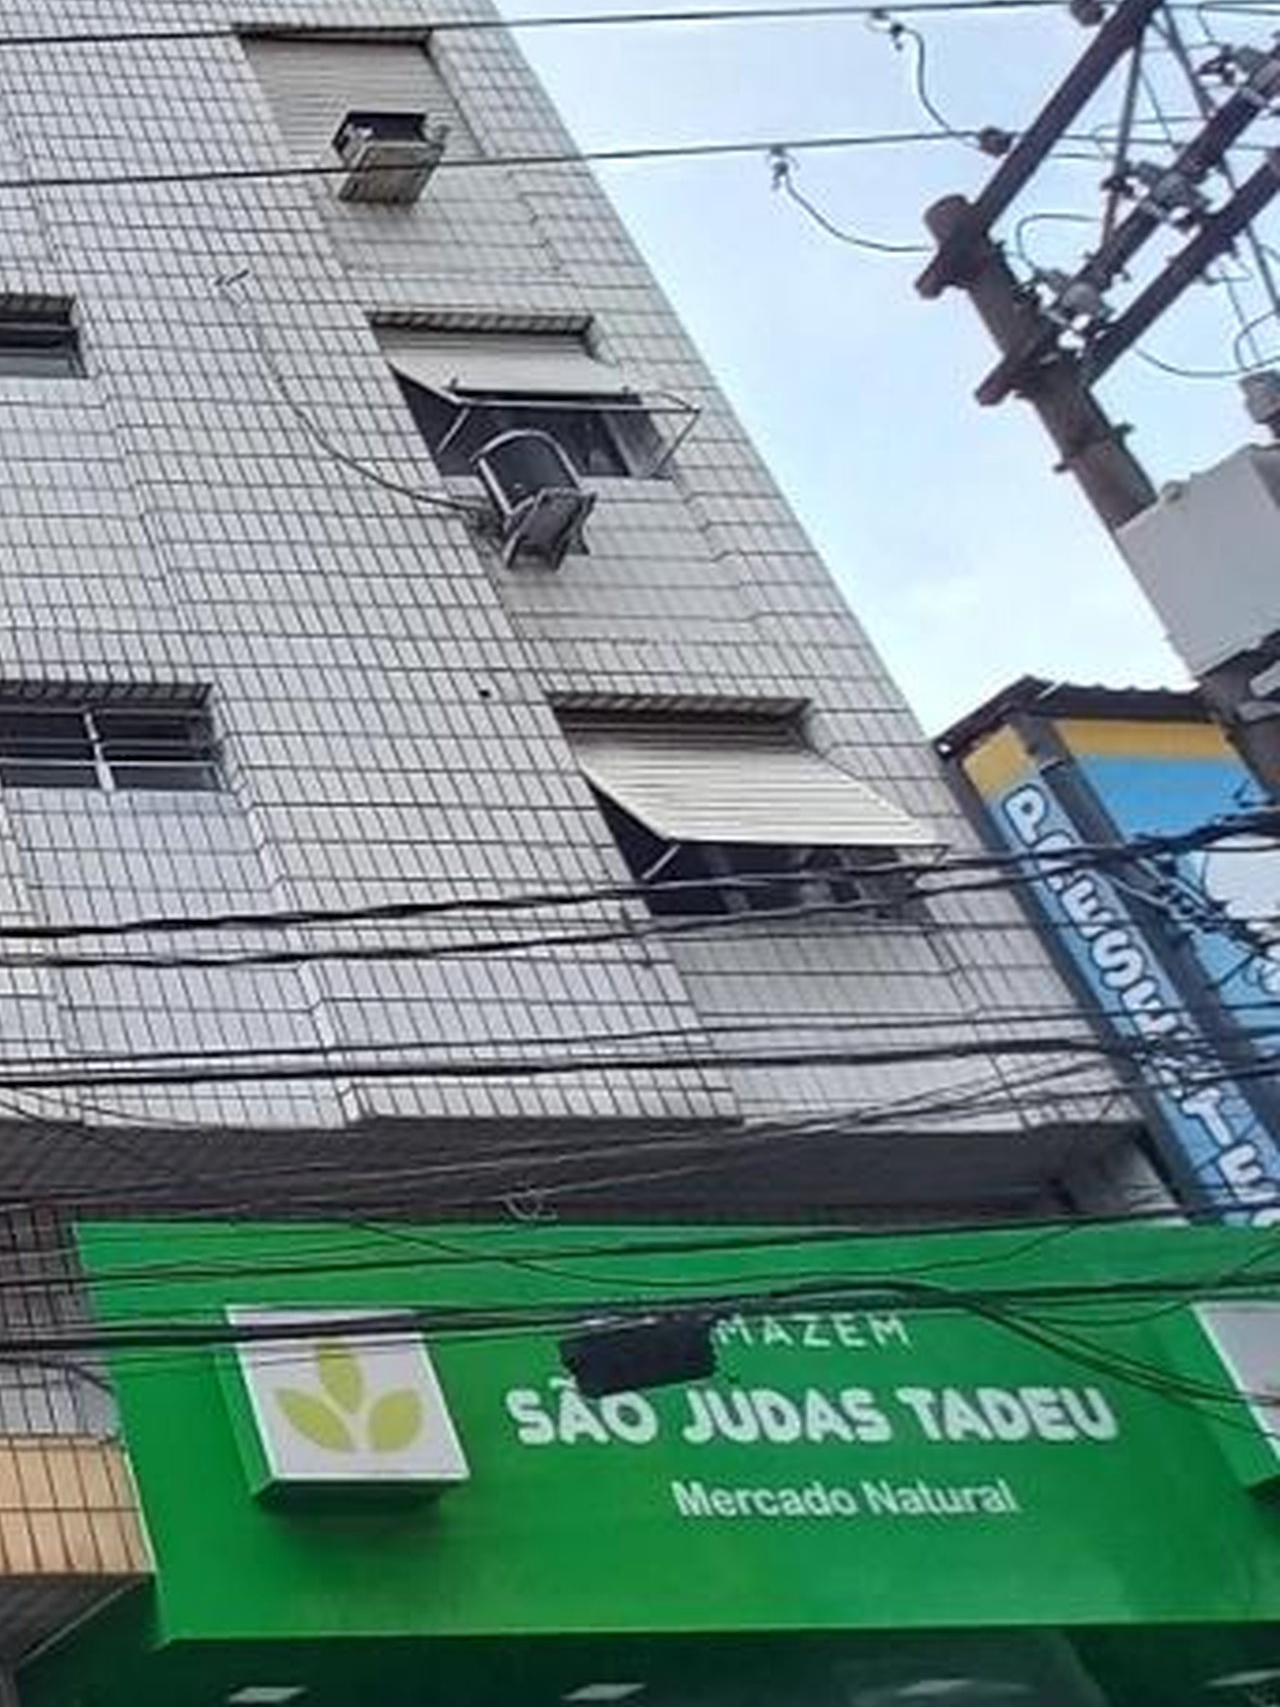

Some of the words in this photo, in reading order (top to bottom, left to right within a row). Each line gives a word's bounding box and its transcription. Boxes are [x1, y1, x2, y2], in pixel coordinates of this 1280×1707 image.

[504, 1376, 659, 1445] SÃO
[682, 1386, 893, 1445] JUDAS
[896, 1386, 1121, 1443] TADEU
[671, 1479, 861, 1520] Mercado
[862, 1477, 1020, 1517] Natural
